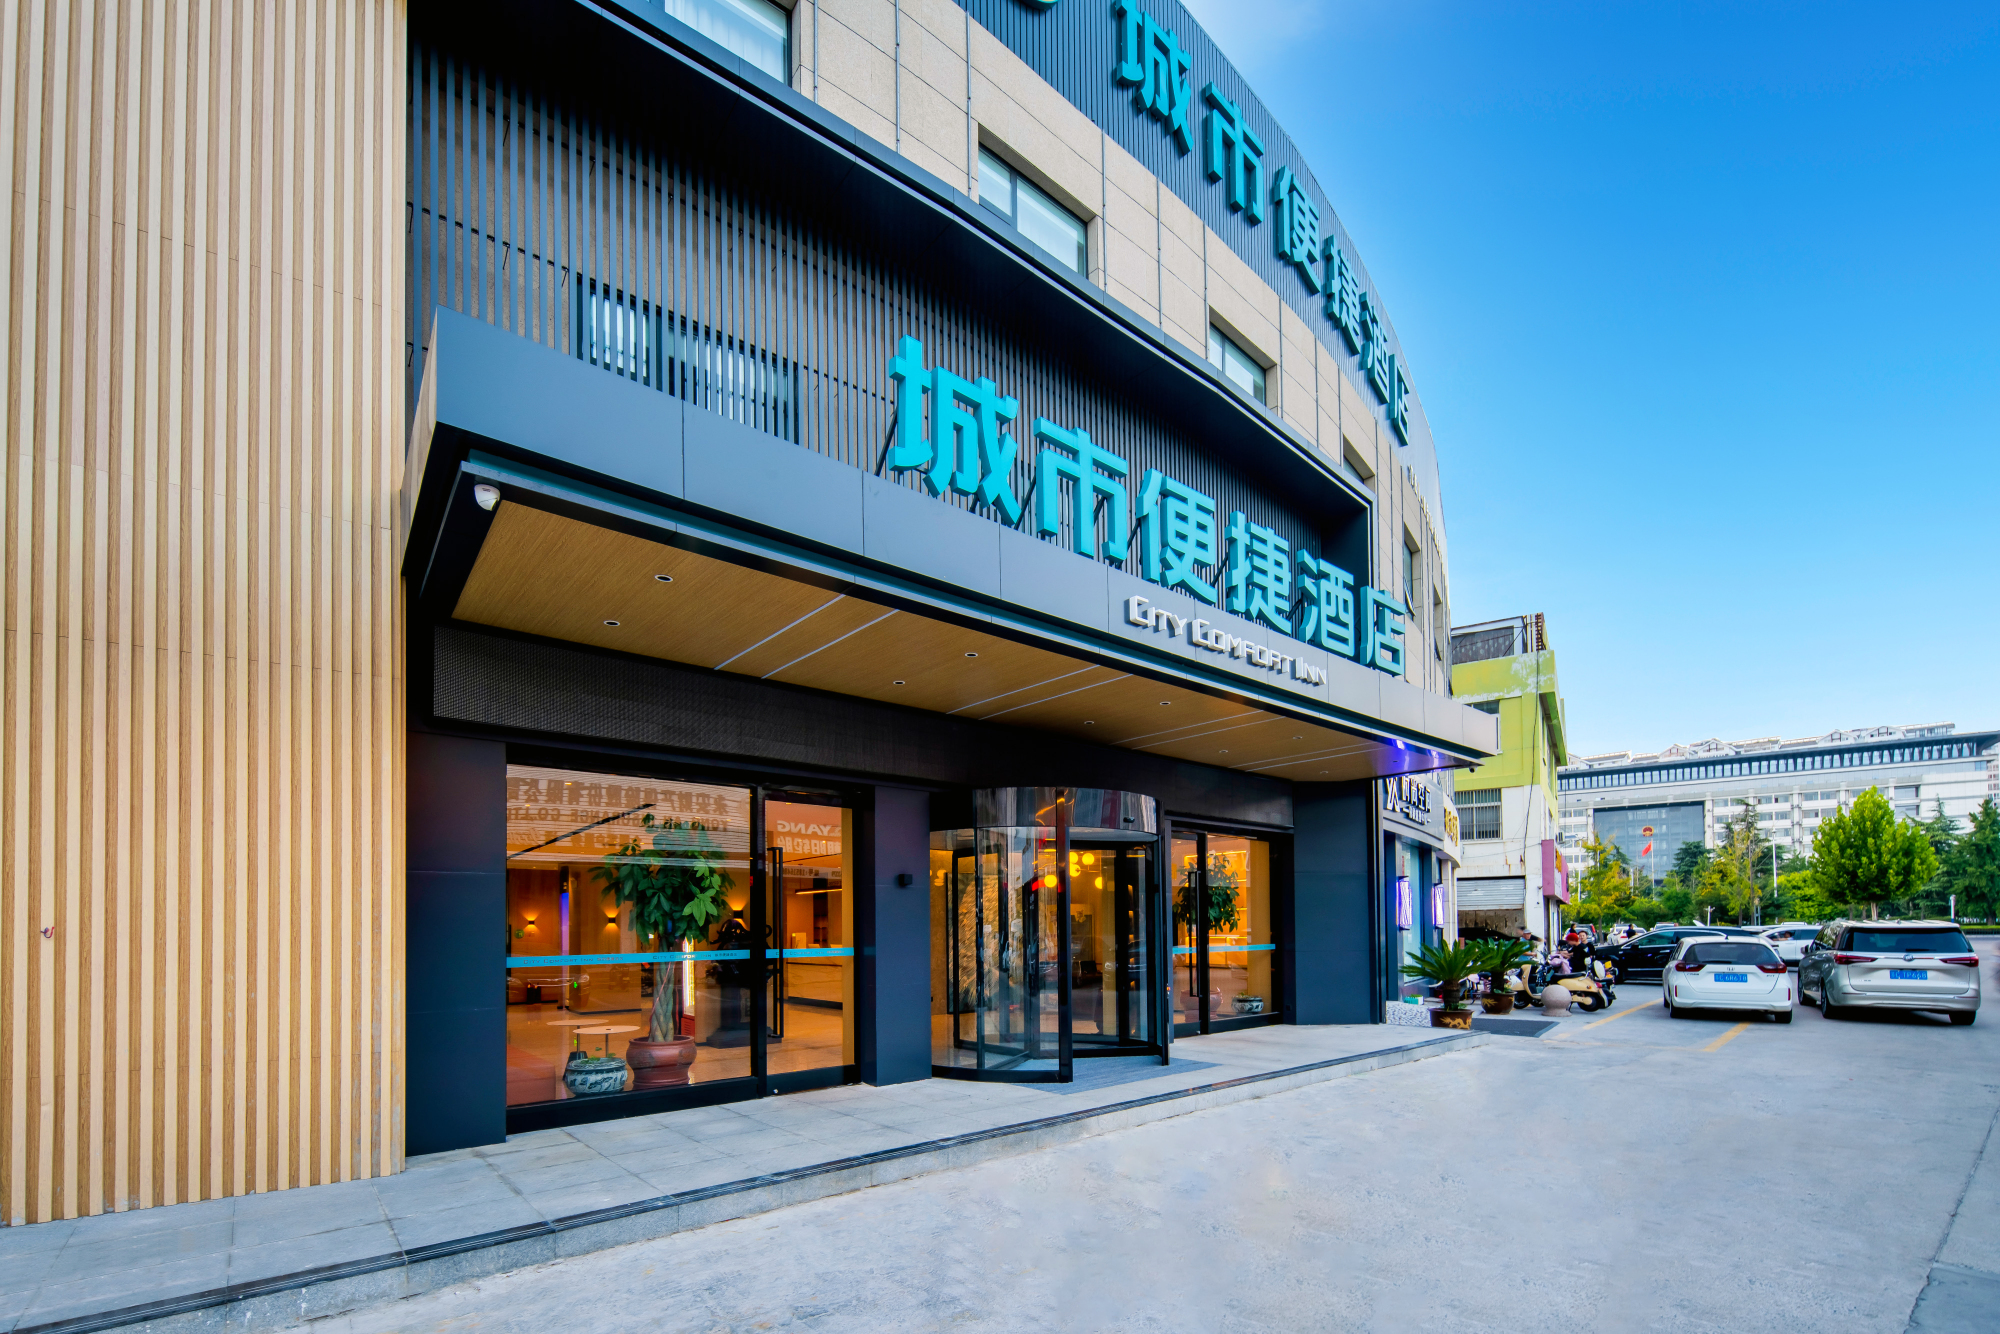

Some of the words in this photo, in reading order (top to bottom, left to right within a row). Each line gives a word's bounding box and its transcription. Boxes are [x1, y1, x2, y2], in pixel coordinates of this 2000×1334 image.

[1116, 0, 1409, 446] 城市便捷酒店
[888, 333, 1406, 677] 城市便捷酒店
[1129, 595, 1187, 636] CITY
[1192, 618, 1293, 673] COMFORT
[1295, 656, 1327, 685] INN
